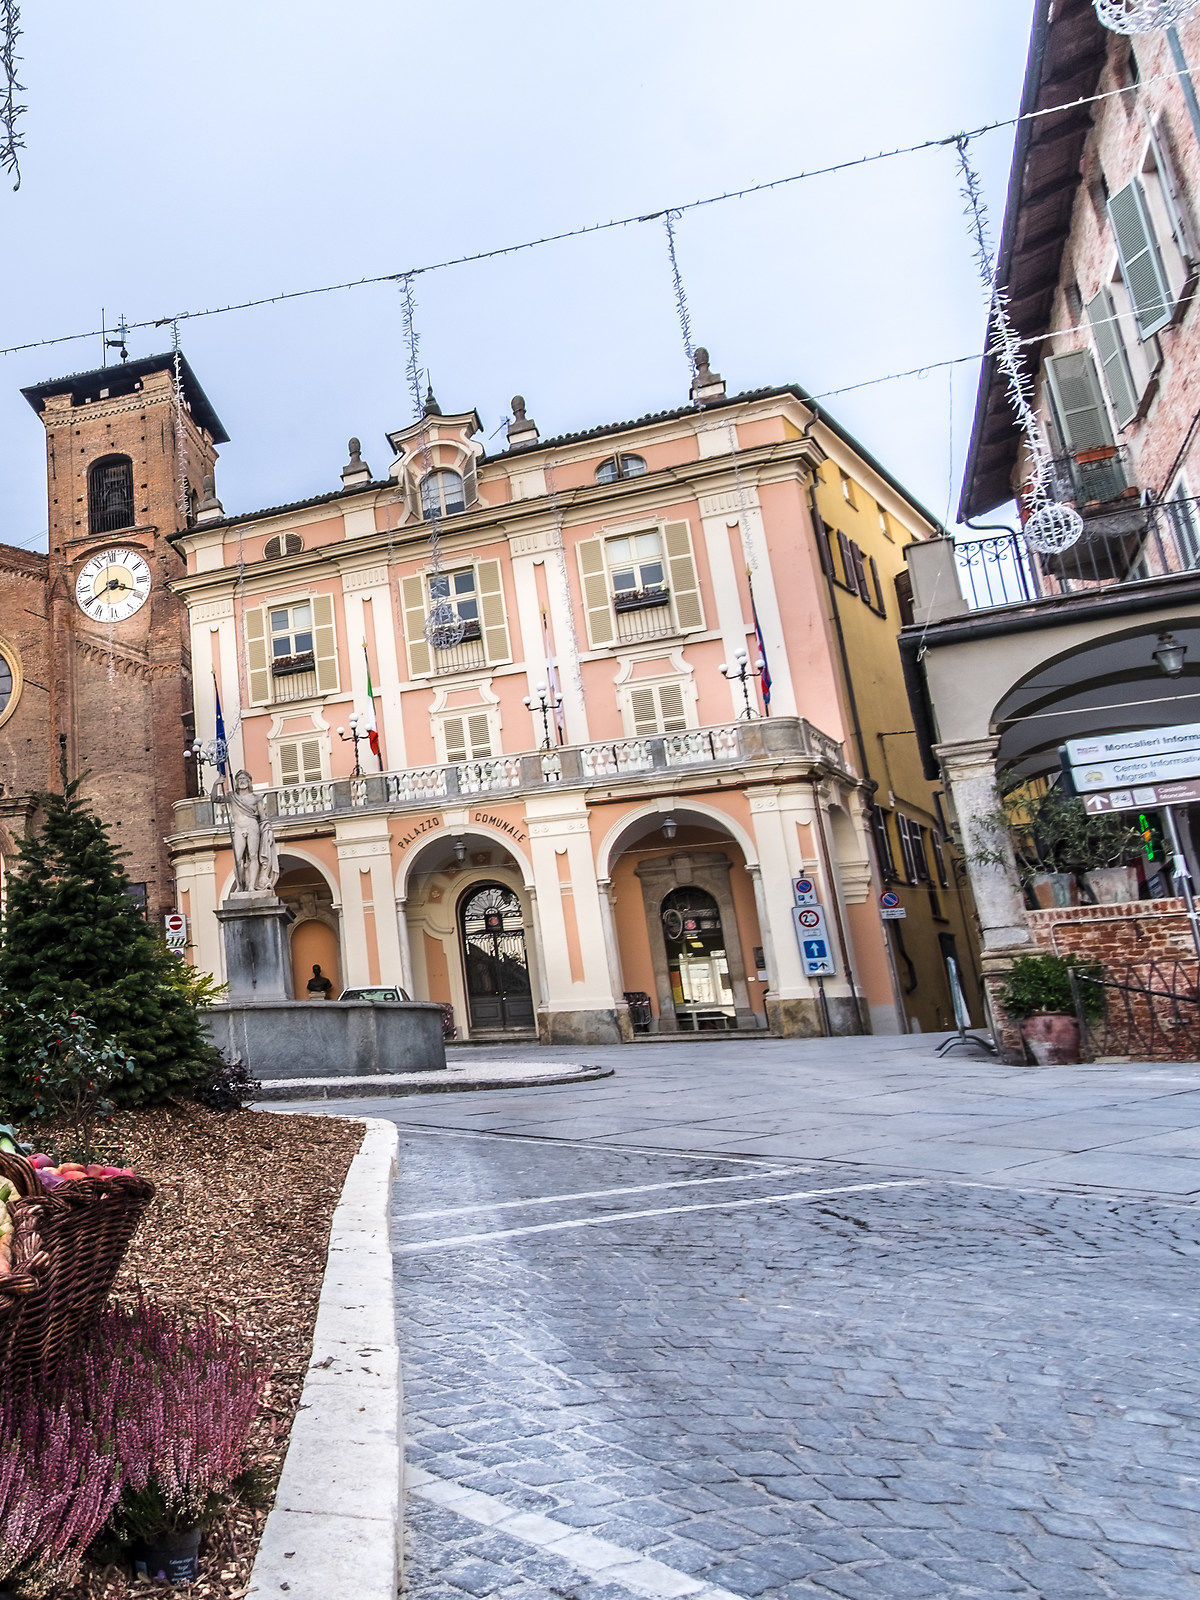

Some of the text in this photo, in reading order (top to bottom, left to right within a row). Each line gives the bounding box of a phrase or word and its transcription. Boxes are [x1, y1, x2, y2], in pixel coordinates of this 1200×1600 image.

[1105, 738, 1160, 752] Moncalieri
[1114, 762, 1148, 773] Centro
[1115, 770, 1157, 782] Migranti
[397, 812, 527, 849] PALAZZO COMUNALE
